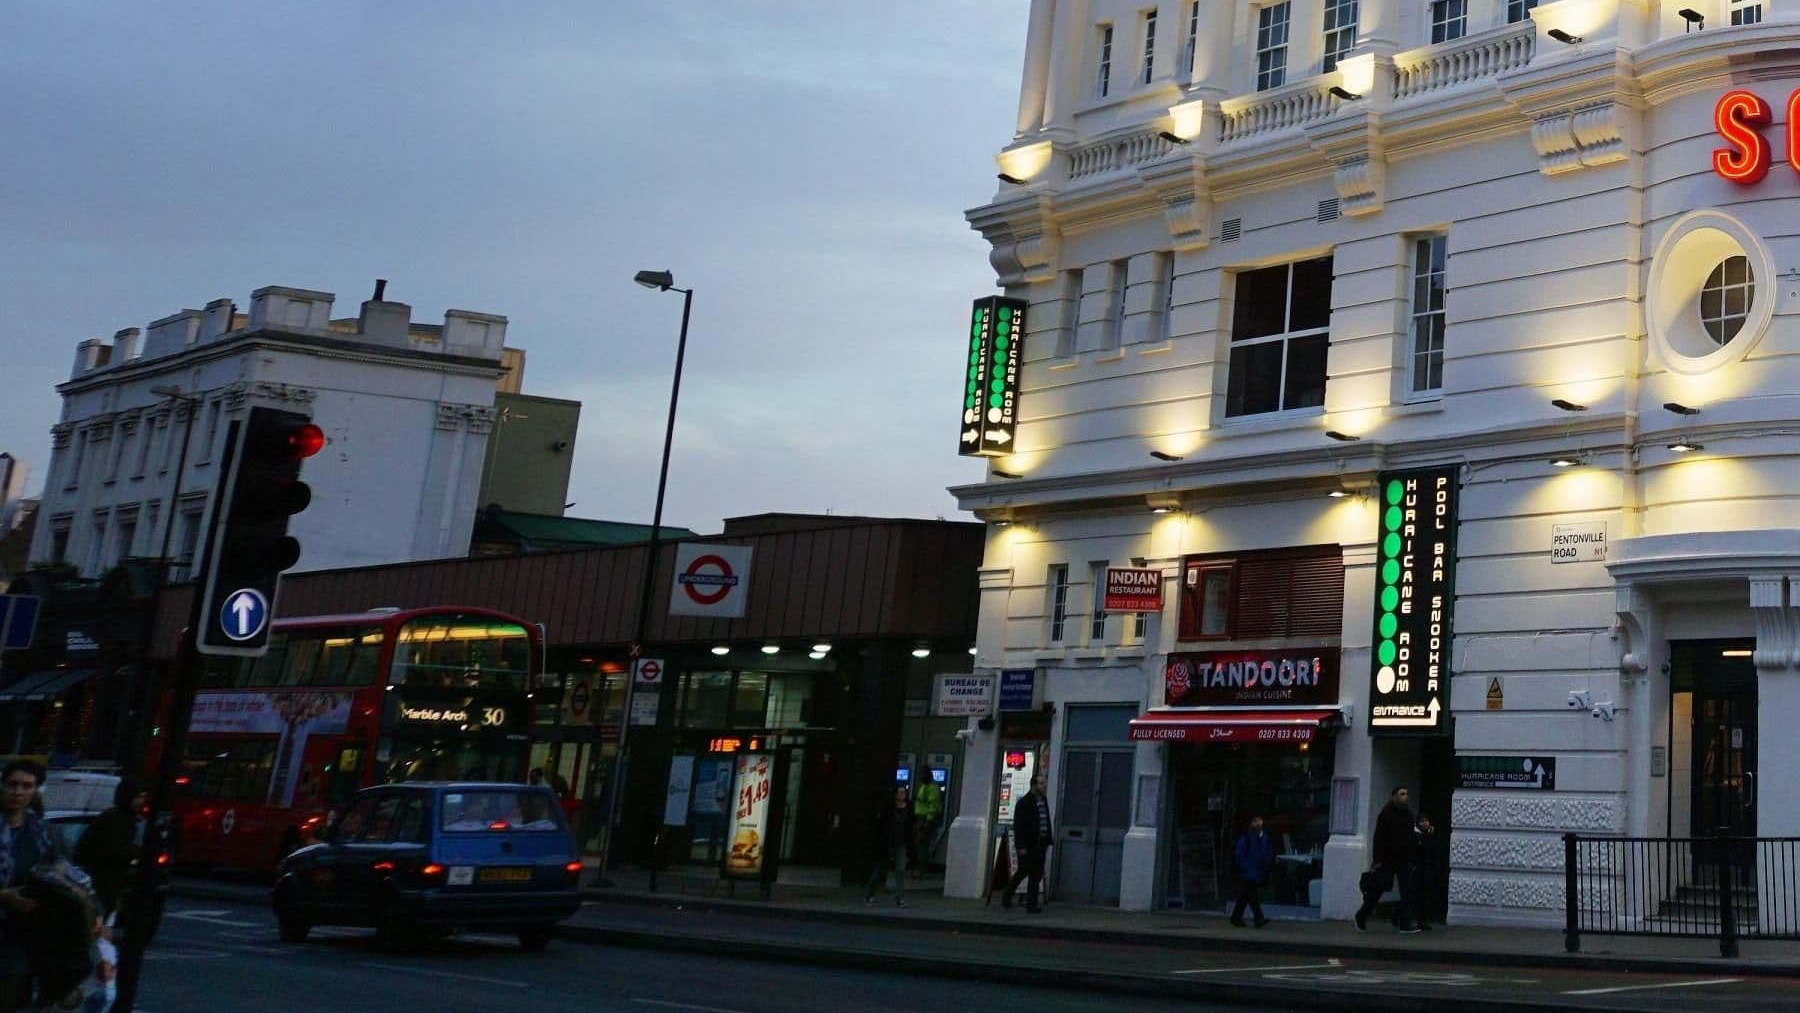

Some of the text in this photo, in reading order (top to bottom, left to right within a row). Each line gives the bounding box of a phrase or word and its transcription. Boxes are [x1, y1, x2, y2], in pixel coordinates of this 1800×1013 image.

[972, 307, 990, 423] HURRICANE ROOM
[1002, 308, 1022, 425] HURRICANE ROOM
[1553, 532, 1604, 545] PENTONVILLE
[1553, 548, 1577, 558] ROAD
[1109, 571, 1158, 585] INDIAN
[1109, 586, 1157, 595] RESTAURANT
[1396, 479, 1417, 692] HURRICANE ROOM
[1428, 477, 1447, 692] POOL BAR SNOOKER
[1200, 658, 1321, 688] TANDOORI
[945, 678, 991, 687] BUREAU DE
[950, 687, 984, 696] CHANGE
[1236, 690, 1292, 700] INDIAN CUISINE
[401, 707, 470, 723] Marble Arch
[480, 707, 506, 727] 30
[1373, 705, 1426, 717] ENTRANCE
[1133, 728, 1186, 739] FULLY LICENSED
[1258, 729, 1311, 739] 0207 833 4308
[1461, 772, 1532, 781] HURRICANE ROOM
